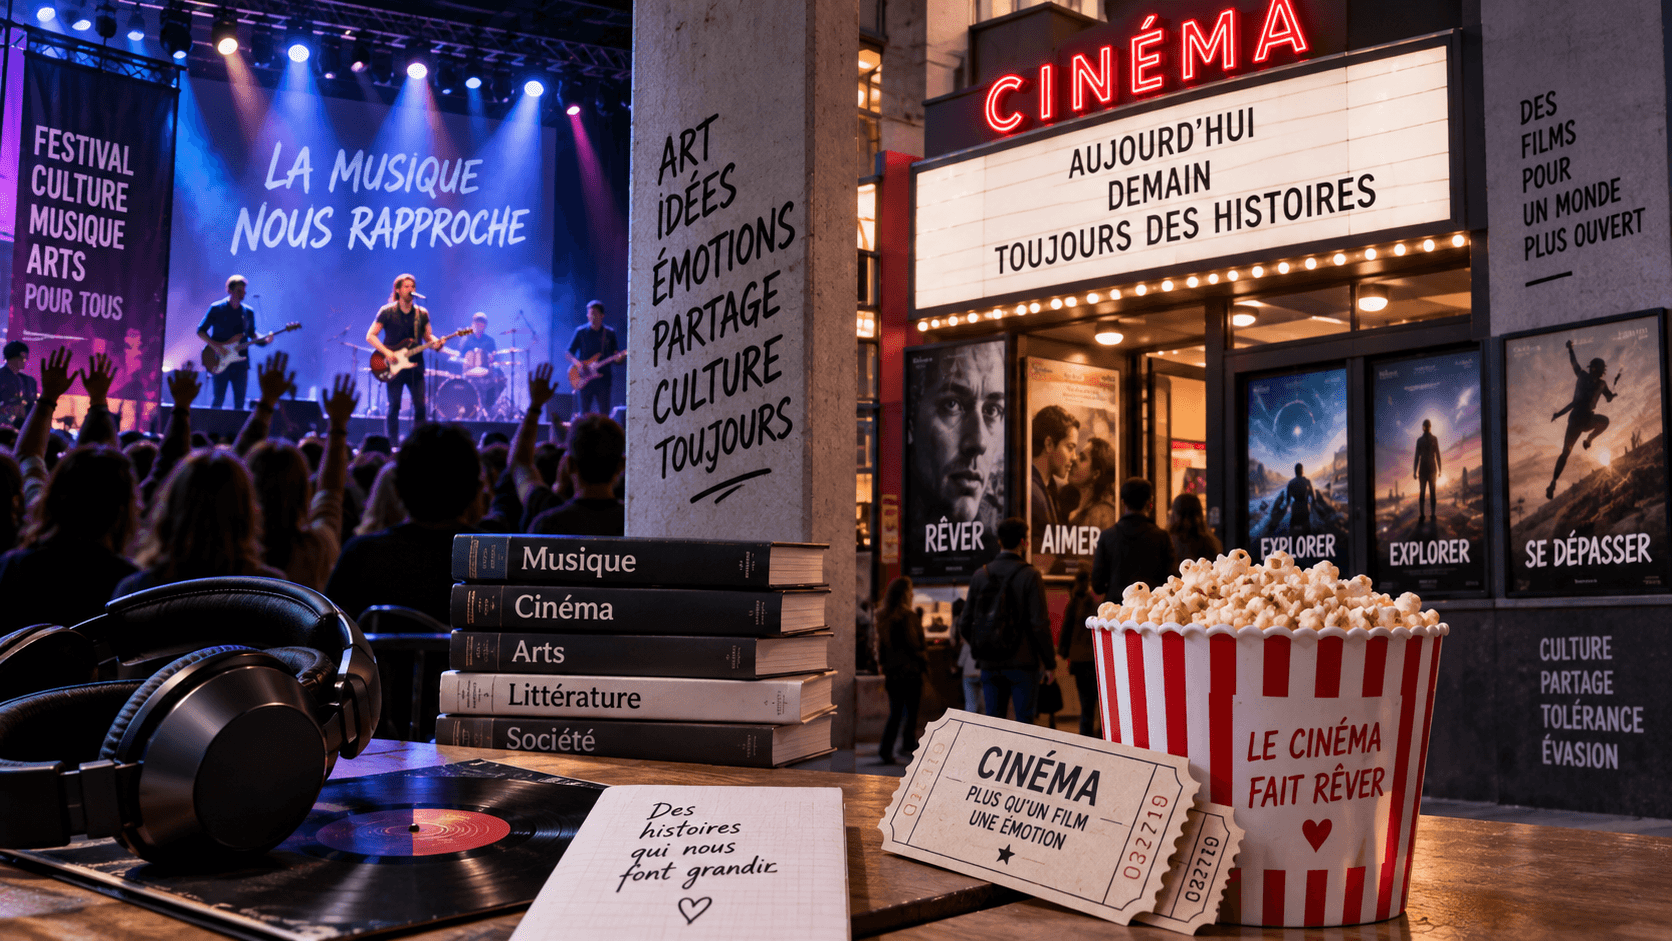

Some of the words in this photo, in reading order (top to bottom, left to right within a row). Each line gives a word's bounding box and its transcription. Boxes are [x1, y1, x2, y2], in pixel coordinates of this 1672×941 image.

[985, 0, 1309, 133] CINÉMA
[1520, 90, 1558, 126] DES
[34, 126, 134, 176] FESTIVAL
[658, 113, 719, 186] ART
[1068, 107, 1256, 180] AUJOURD'HUI
[1521, 119, 1576, 159] FILMS
[264, 141, 313, 194] LA
[1108, 161, 1212, 211] DEMAIN
[1522, 156, 1571, 193] POUR
[31, 165, 129, 213] CULTURE
[1523, 197, 1548, 227] UN
[1556, 177, 1621, 218] MONDE
[29, 204, 125, 250] MUSIQUE
[230, 201, 333, 255] NOUS
[347, 205, 530, 250] RAPPROCHE
[995, 220, 1132, 275] TOUJOURS
[1146, 208, 1200, 246] DES
[1214, 173, 1376, 234] HISTOIRES
[1524, 227, 1567, 261] PLUS
[1574, 207, 1646, 248] OUVERT
[26, 243, 86, 282] ARTS
[652, 200, 796, 306] ÉMOTIONS
[24, 283, 73, 315] POUR
[80, 289, 123, 321] TOUS
[652, 270, 781, 367] PARTAGE
[653, 334, 783, 424] CULTURE
[654, 396, 793, 479] TOUJOURS
[924, 516, 985, 553] RÊVER
[1040, 524, 1101, 555] AIMER
[1389, 538, 1471, 566] EXPLORER
[1524, 539, 1548, 569] SE
[1553, 530, 1653, 566] DÉPASSER
[521, 546, 637, 578] Musique
[514, 594, 614, 621] Cinéma
[511, 639, 565, 664] Arts
[1540, 635, 1613, 662] CULTURE
[508, 683, 641, 709] Littérature
[1540, 670, 1614, 696] PARTAGE
[1541, 701, 1645, 735] TOLÉRANCE
[506, 726, 596, 752] Société
[1247, 731, 1277, 762] LE
[1289, 717, 1382, 760] CINÉMA
[1542, 735, 1619, 770] ÉVASION
[977, 745, 1101, 806] CINÉMA
[1248, 772, 1304, 809] FAIT
[1312, 763, 1385, 803] RÊVER
[646, 801, 696, 820] Des
[965, 785, 1001, 808] PLUS
[1004, 794, 1050, 822] QU'UN
[1051, 807, 1089, 832] FILM
[639, 820, 741, 839] histoires
[968, 809, 997, 831] UNE
[999, 814, 1067, 850] ÉMOTION
[1123, 795, 1168, 880] 032719
[630, 843, 671, 864] qui
[682, 841, 736, 856] nous
[615, 862, 676, 893] font
[681, 855, 778, 890] grandir
